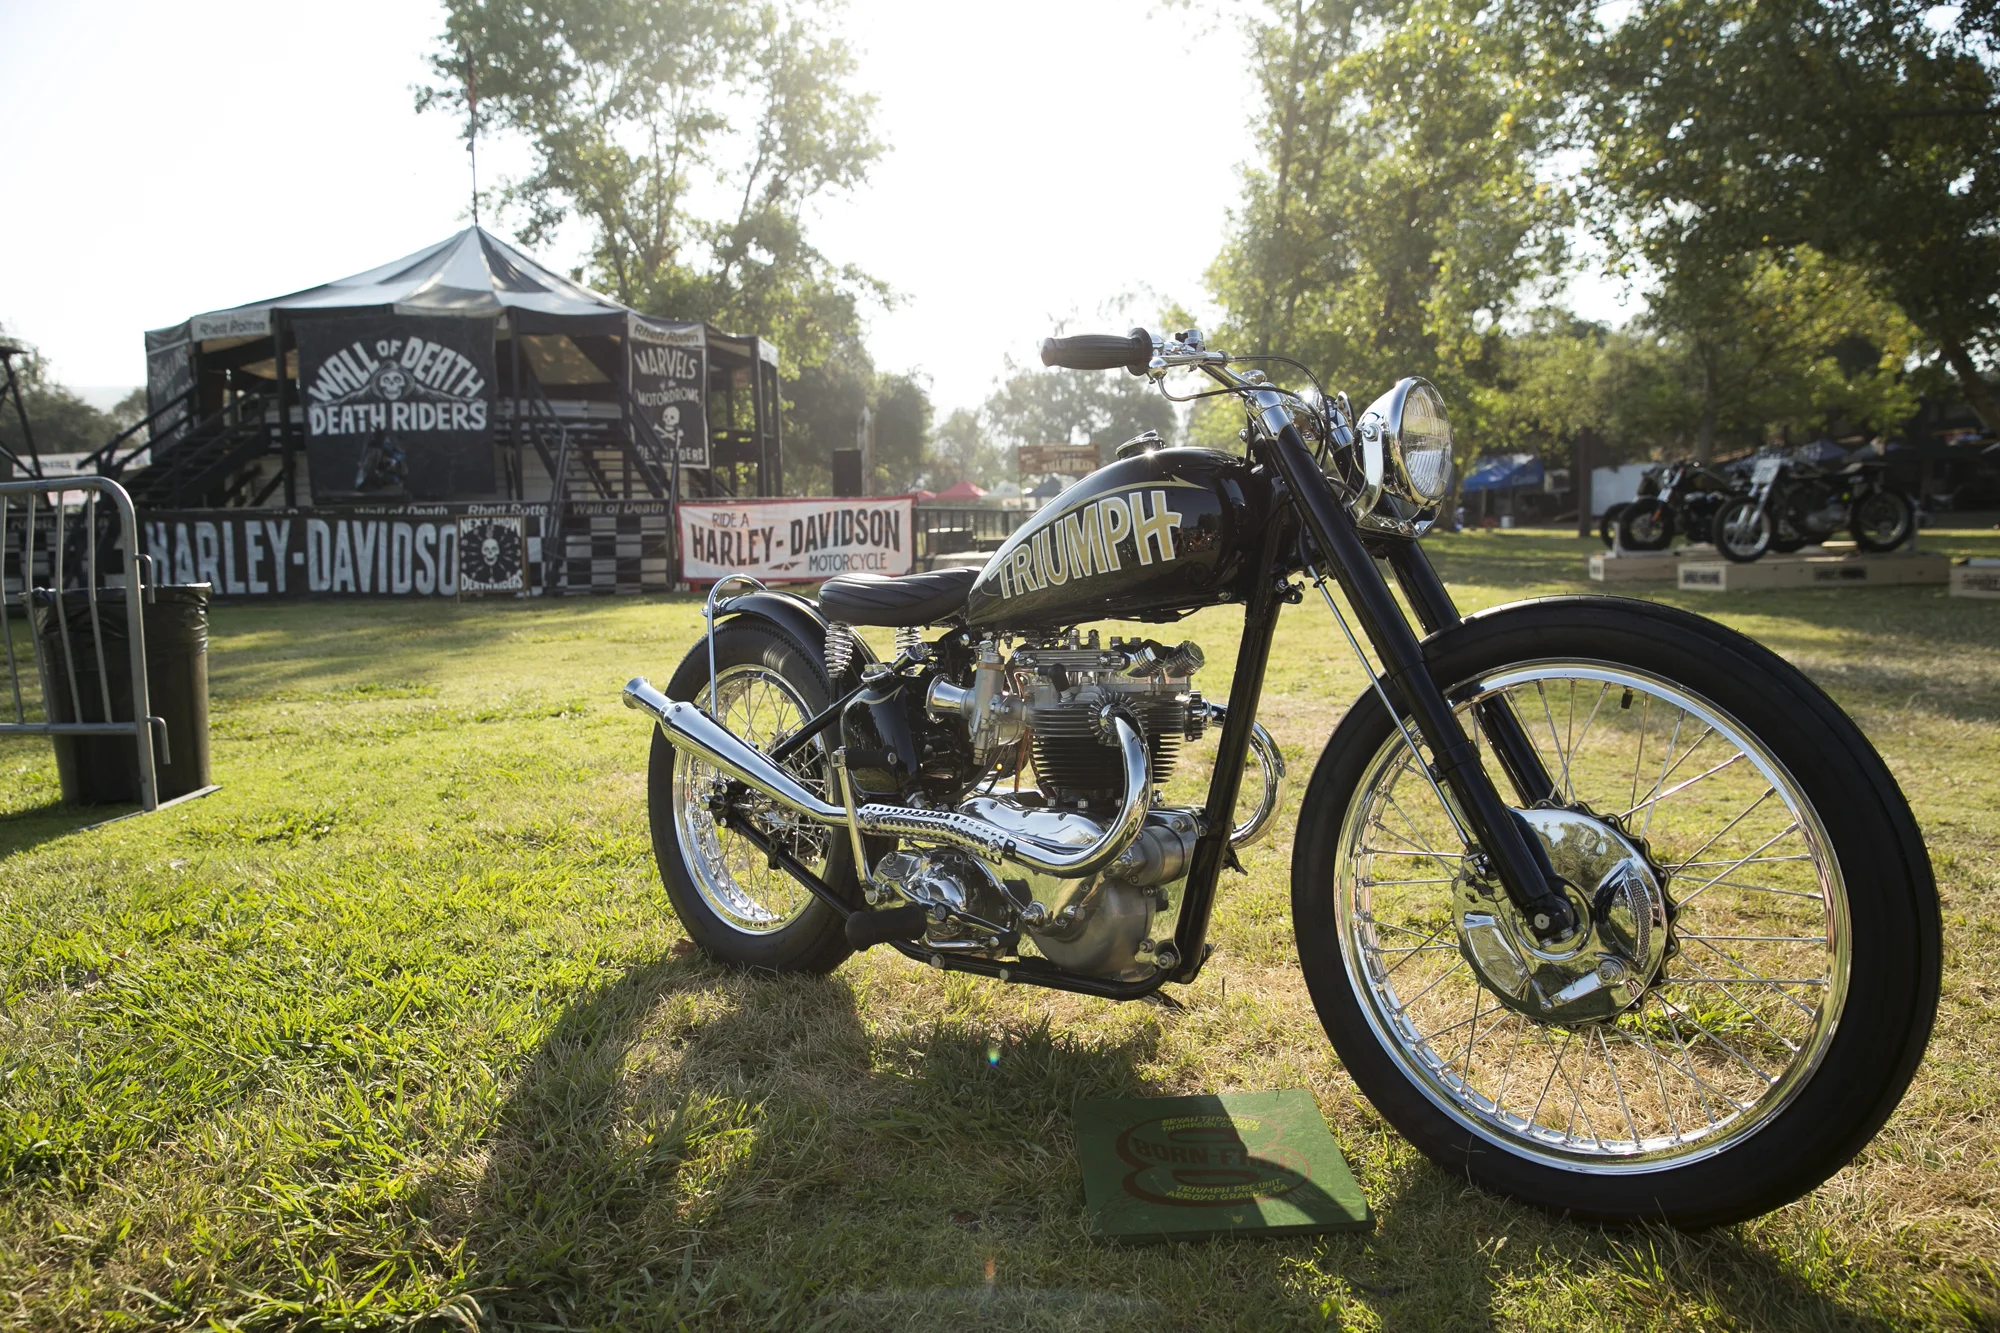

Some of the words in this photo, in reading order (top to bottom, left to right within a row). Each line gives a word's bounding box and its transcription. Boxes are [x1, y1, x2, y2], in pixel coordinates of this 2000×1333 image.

[308, 341, 380, 400] WALL
[376, 339, 402, 357] OF
[401, 336, 485, 397] DEATH
[309, 403, 386, 436] DEATH
[391, 402, 487, 431] RIDERS
[407, 505, 448, 515] Death
[468, 505, 506, 515] Rhett
[573, 503, 602, 515] Wall
[606, 503, 620, 514] of
[624, 502, 664, 514] Death
[460, 518, 489, 538] NEXT
[492, 517, 522, 538] SHOW
[712, 512, 737, 529] RIDE
[742, 512, 750, 528] A
[987, 490, 1182, 599] TRIUMPH
[145, 519, 457, 596] HARLEY-DAVIDSO
[809, 552, 887, 572] MOTORCYCLE
[1161, 1122, 1217, 1132] THOMPSON
[1220, 1122, 1260, 1131] CYCLES
[1162, 1116, 1198, 1126] BRYAN
[1201, 1115, 1261, 1126] THOMPSON
[1166, 1190, 1216, 1200] ARROYO
[1273, 1184, 1288, 1192] CA
[1176, 1184, 1230, 1194] TRIUMPH
